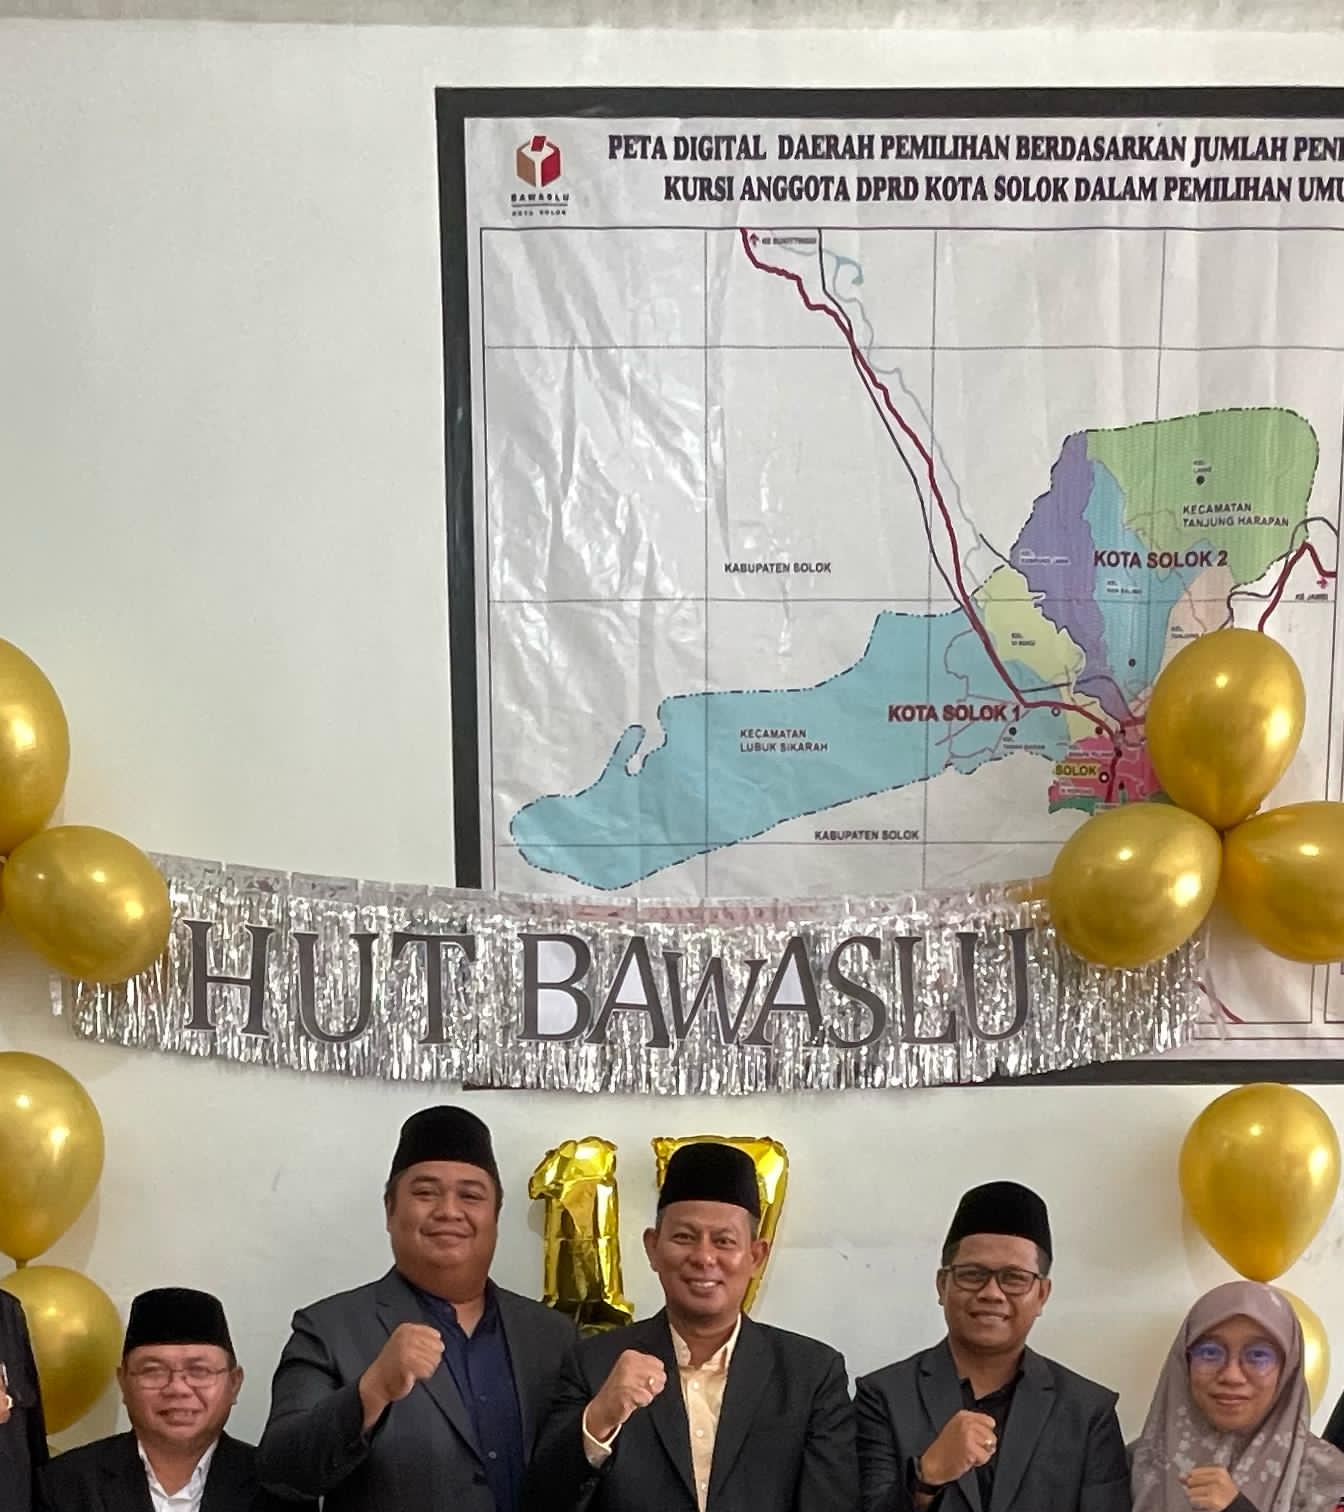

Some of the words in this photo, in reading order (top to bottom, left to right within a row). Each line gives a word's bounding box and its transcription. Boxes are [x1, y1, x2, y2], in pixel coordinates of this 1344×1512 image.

[608, 135, 666, 160] PETA
[673, 135, 767, 160] DIGITAL
[779, 135, 875, 161] DAERAH
[880, 135, 1010, 161] PEMILIHAN
[1017, 136, 1186, 162] BERDASARKAN
[1191, 136, 1287, 167] JUMLAH
[664, 176, 734, 201] KURSI
[740, 176, 850, 201] ANGGOTA
[856, 176, 919, 201] DPRD
[924, 176, 988, 201] KOTA
[994, 176, 1069, 202] SOLOK
[1074, 176, 1157, 202] DALAM
[1163, 177, 1292, 202] PEMILIHAN
[1183, 503, 1252, 514] KECAMATAN
[1183, 516, 1234, 527] TANJUNG
[1238, 517, 1289, 527] HARAPAN
[1094, 551, 1142, 568] KOTA
[1147, 551, 1210, 569] SOLOK
[1216, 550, 1228, 566] 2
[725, 562, 788, 573] KABUPATEN
[793, 562, 831, 574] SOLOK
[888, 705, 937, 723] KOTA
[943, 704, 1007, 723] SOLOK
[1011, 704, 1020, 721] 1
[740, 728, 807, 740] KECAMATAN
[740, 742, 777, 752] LUBUK
[781, 742, 829, 753] SIKARAH
[1055, 765, 1097, 776] SOLOK
[814, 830, 878, 841] KABUPATEN
[881, 830, 920, 841] SOLOK
[183, 919, 478, 1043] HUT
[517, 927, 1034, 1050] BAWASLU
